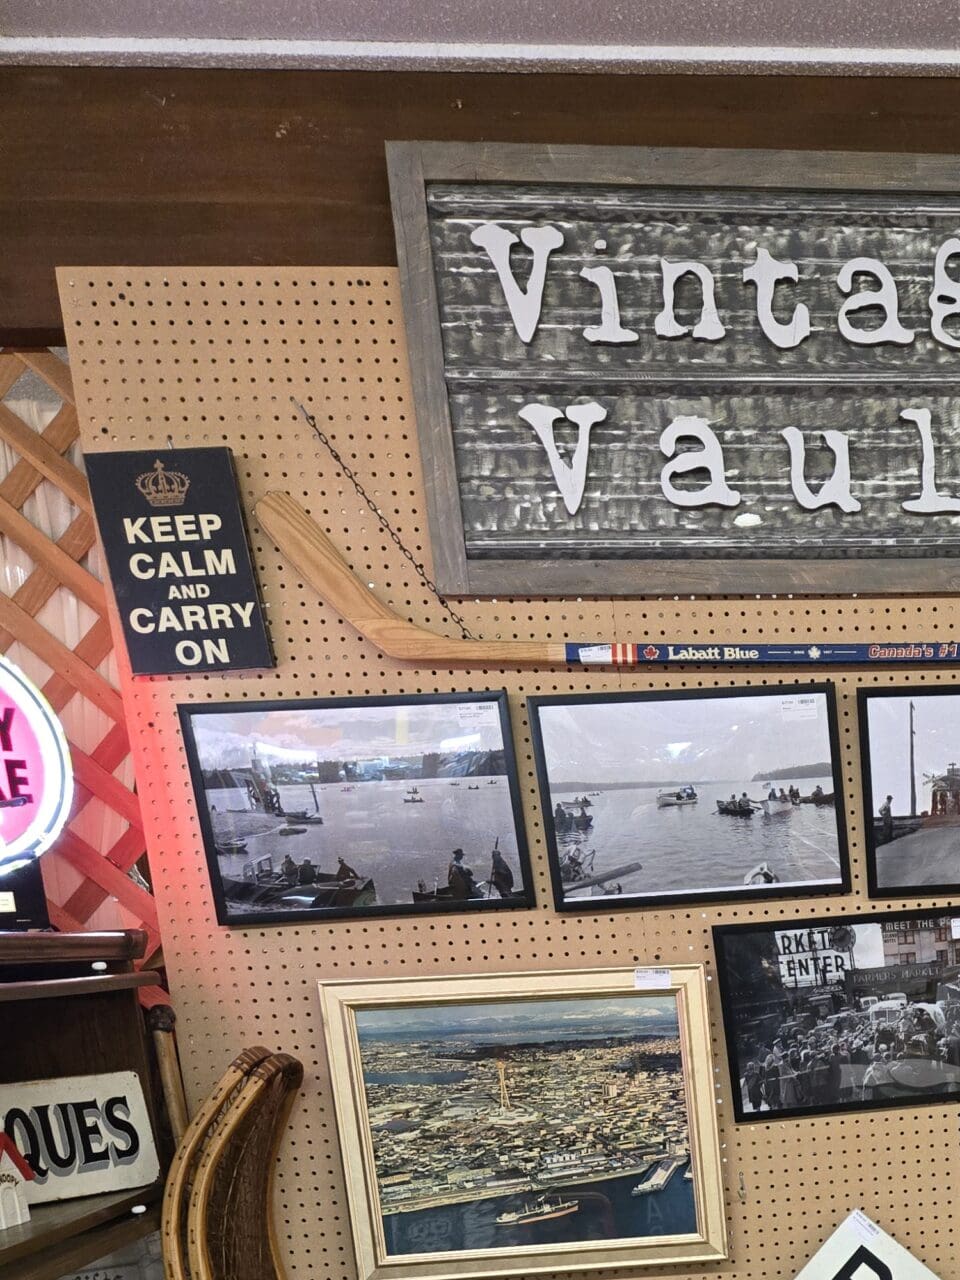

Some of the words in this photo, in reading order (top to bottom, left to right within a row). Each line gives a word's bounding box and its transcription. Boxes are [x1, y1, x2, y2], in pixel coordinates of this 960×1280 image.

[122, 514, 222, 544] KEEP
[128, 548, 236, 580] CALM
[168, 583, 210, 600] AND
[129, 601, 256, 635] CARRY
[175, 638, 230, 666] ON
[667, 646, 720, 661] Labatt
[723, 646, 759, 660] Blue
[868, 644, 934, 659] Canada's
[939, 643, 958, 659] #1
[0, 759, 33, 804] E
[885, 921, 911, 931] MEET
[917, 919, 934, 928] THE
[780, 954, 846, 978] ENTER
[4, 1095, 140, 1182] QUES
